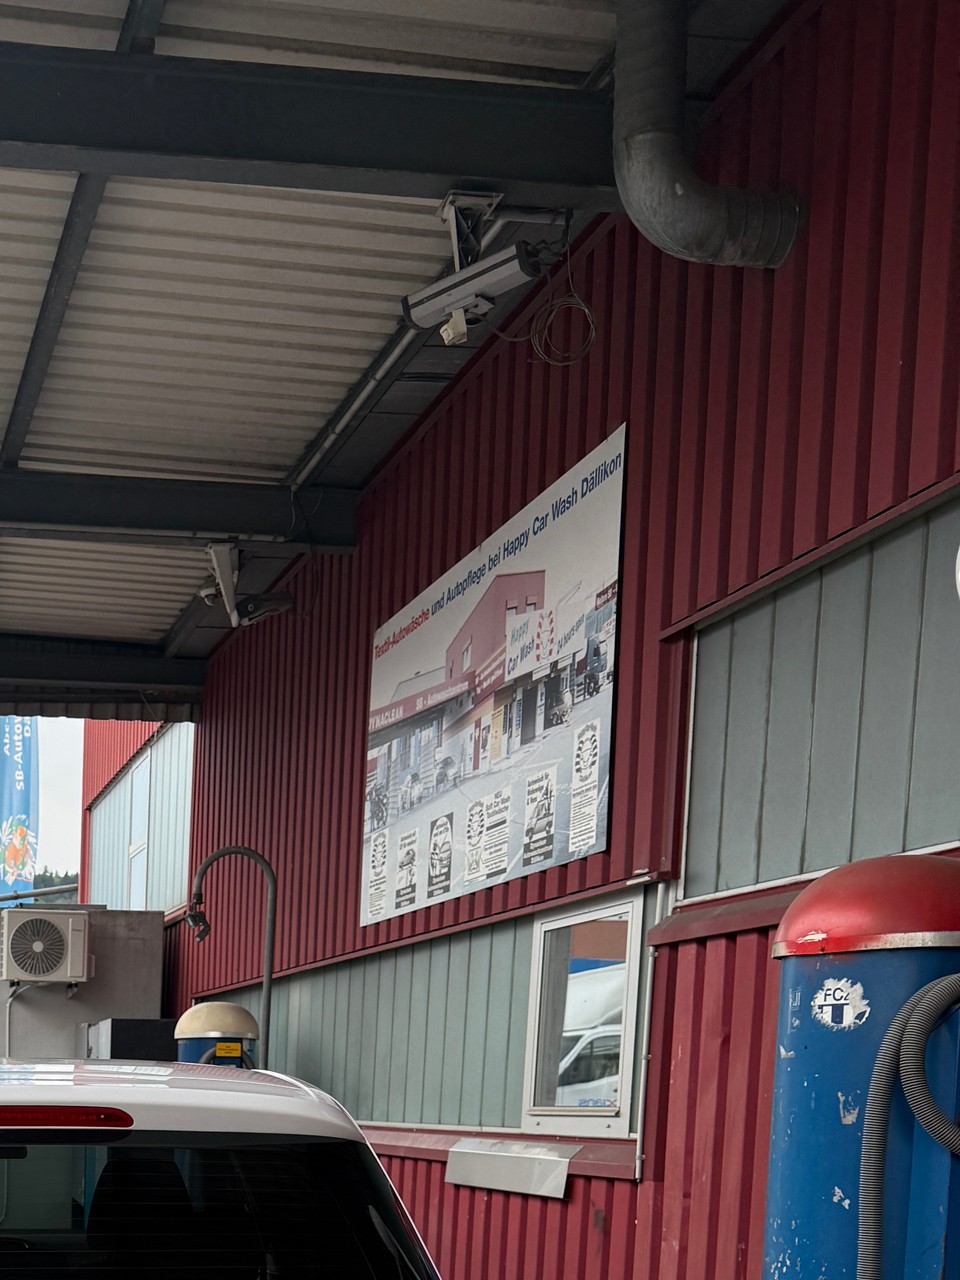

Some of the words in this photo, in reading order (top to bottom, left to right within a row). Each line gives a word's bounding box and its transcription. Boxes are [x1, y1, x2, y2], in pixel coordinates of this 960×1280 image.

[374, 607, 430, 660] Textil-Autowäsche
[431, 592, 444, 616] und
[445, 563, 486, 605] Autopflege
[488, 547, 500, 573] bei
[503, 526, 530, 561] Happy
[532, 514, 548, 537] Car
[552, 487, 578, 522] Wash
[580, 452, 622, 499] Dällikon
[508, 653, 519, 676] Car
[520, 635, 535, 662] Wash
